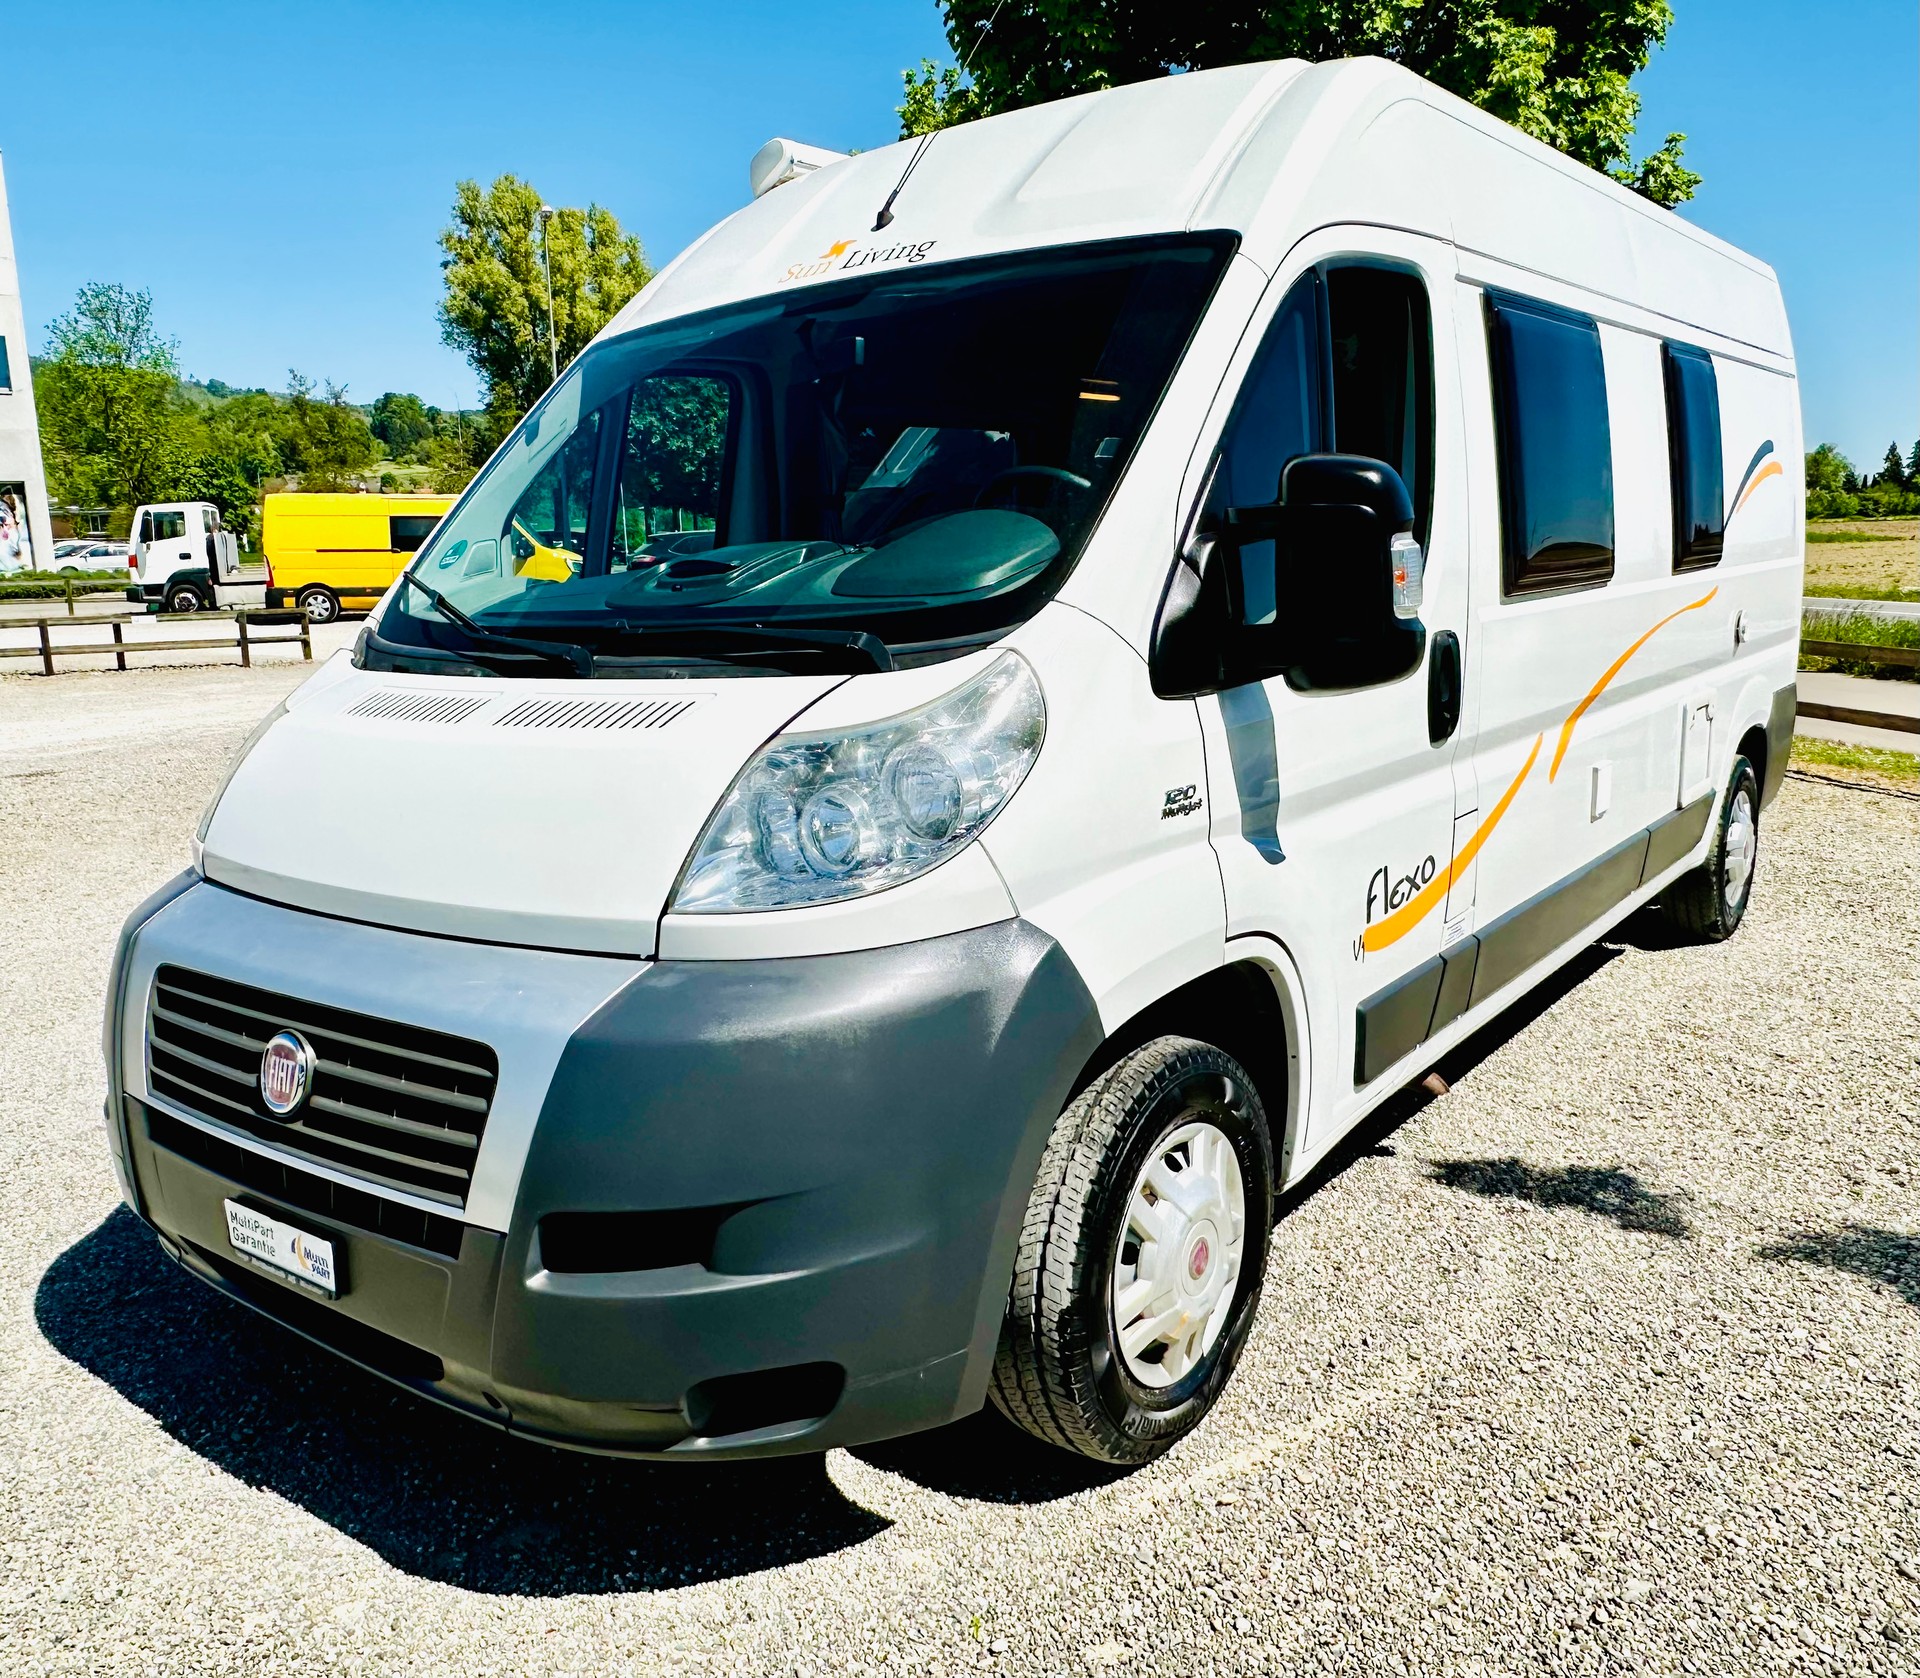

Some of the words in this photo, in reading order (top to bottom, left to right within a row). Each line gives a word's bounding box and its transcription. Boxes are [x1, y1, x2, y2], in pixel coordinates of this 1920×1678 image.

[778, 260, 832, 283] Sun
[839, 240, 938, 271] Living
[269, 1054, 297, 1094] FIAT
[230, 1210, 275, 1240] MultiPart
[232, 1226, 277, 1257] Garantie
